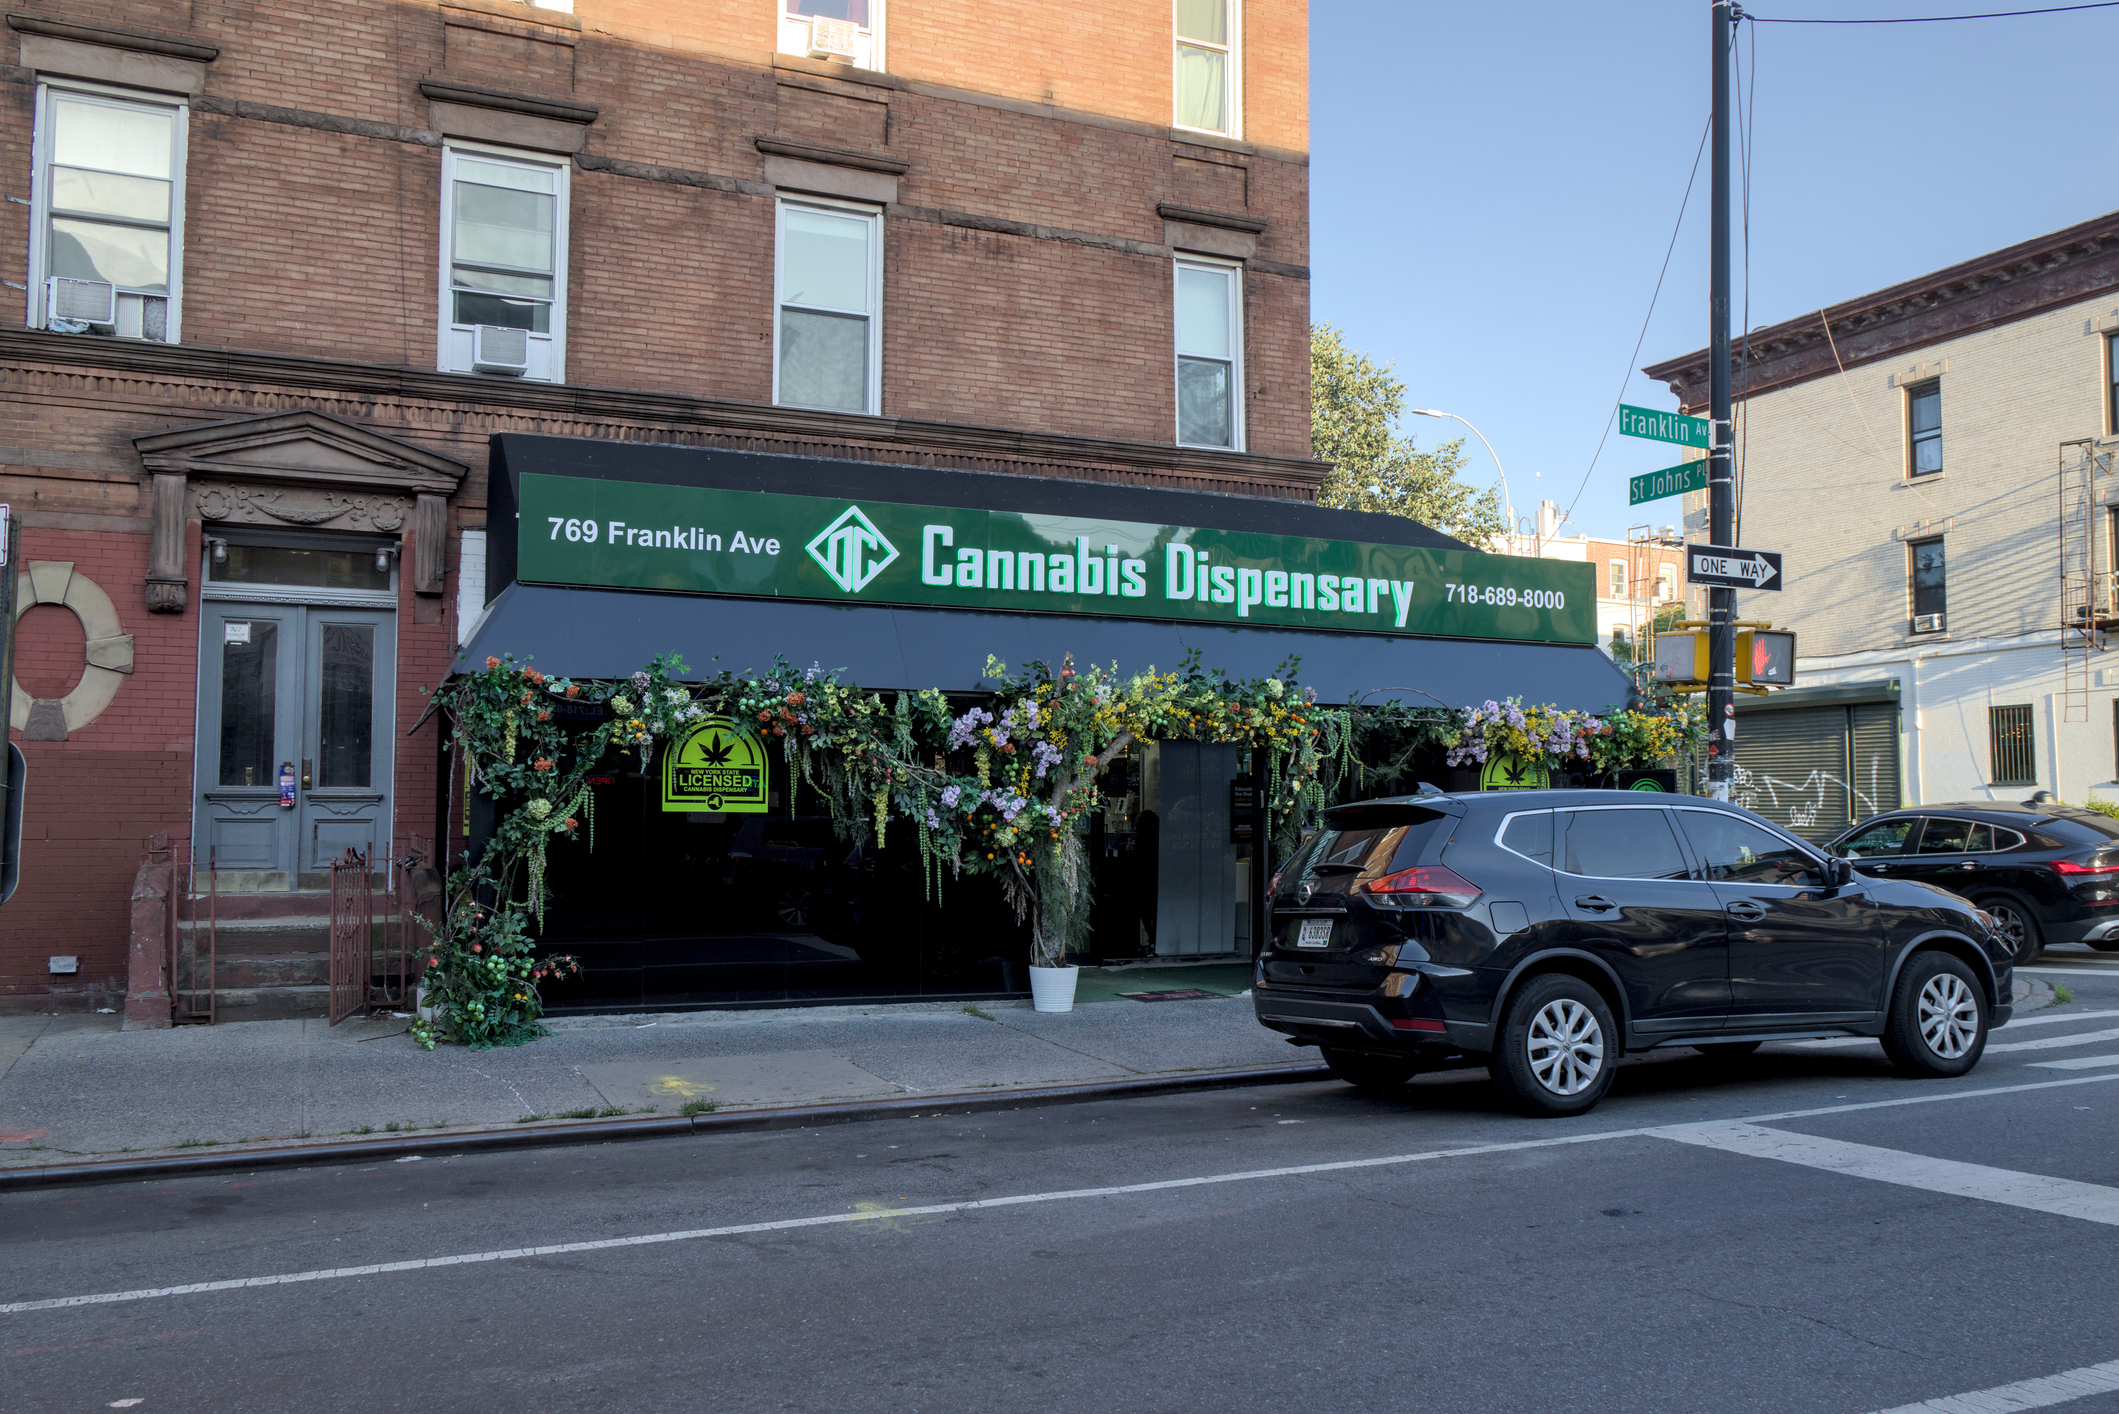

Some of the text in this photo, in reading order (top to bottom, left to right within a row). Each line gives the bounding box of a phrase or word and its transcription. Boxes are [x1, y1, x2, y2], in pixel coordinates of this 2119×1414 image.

[1622, 409, 1707, 442] Franklin Av
[1632, 478, 1645, 501] St
[1650, 470, 1691, 497] Johns
[547, 516, 781, 555] 769 Franklin Ave
[922, 524, 1414, 628] Cannabis Dispensary
[1700, 557, 1768, 578] ONE WAY
[1445, 583, 1566, 610] 718-689-8000
[679, 774, 752, 786] LICENSED
